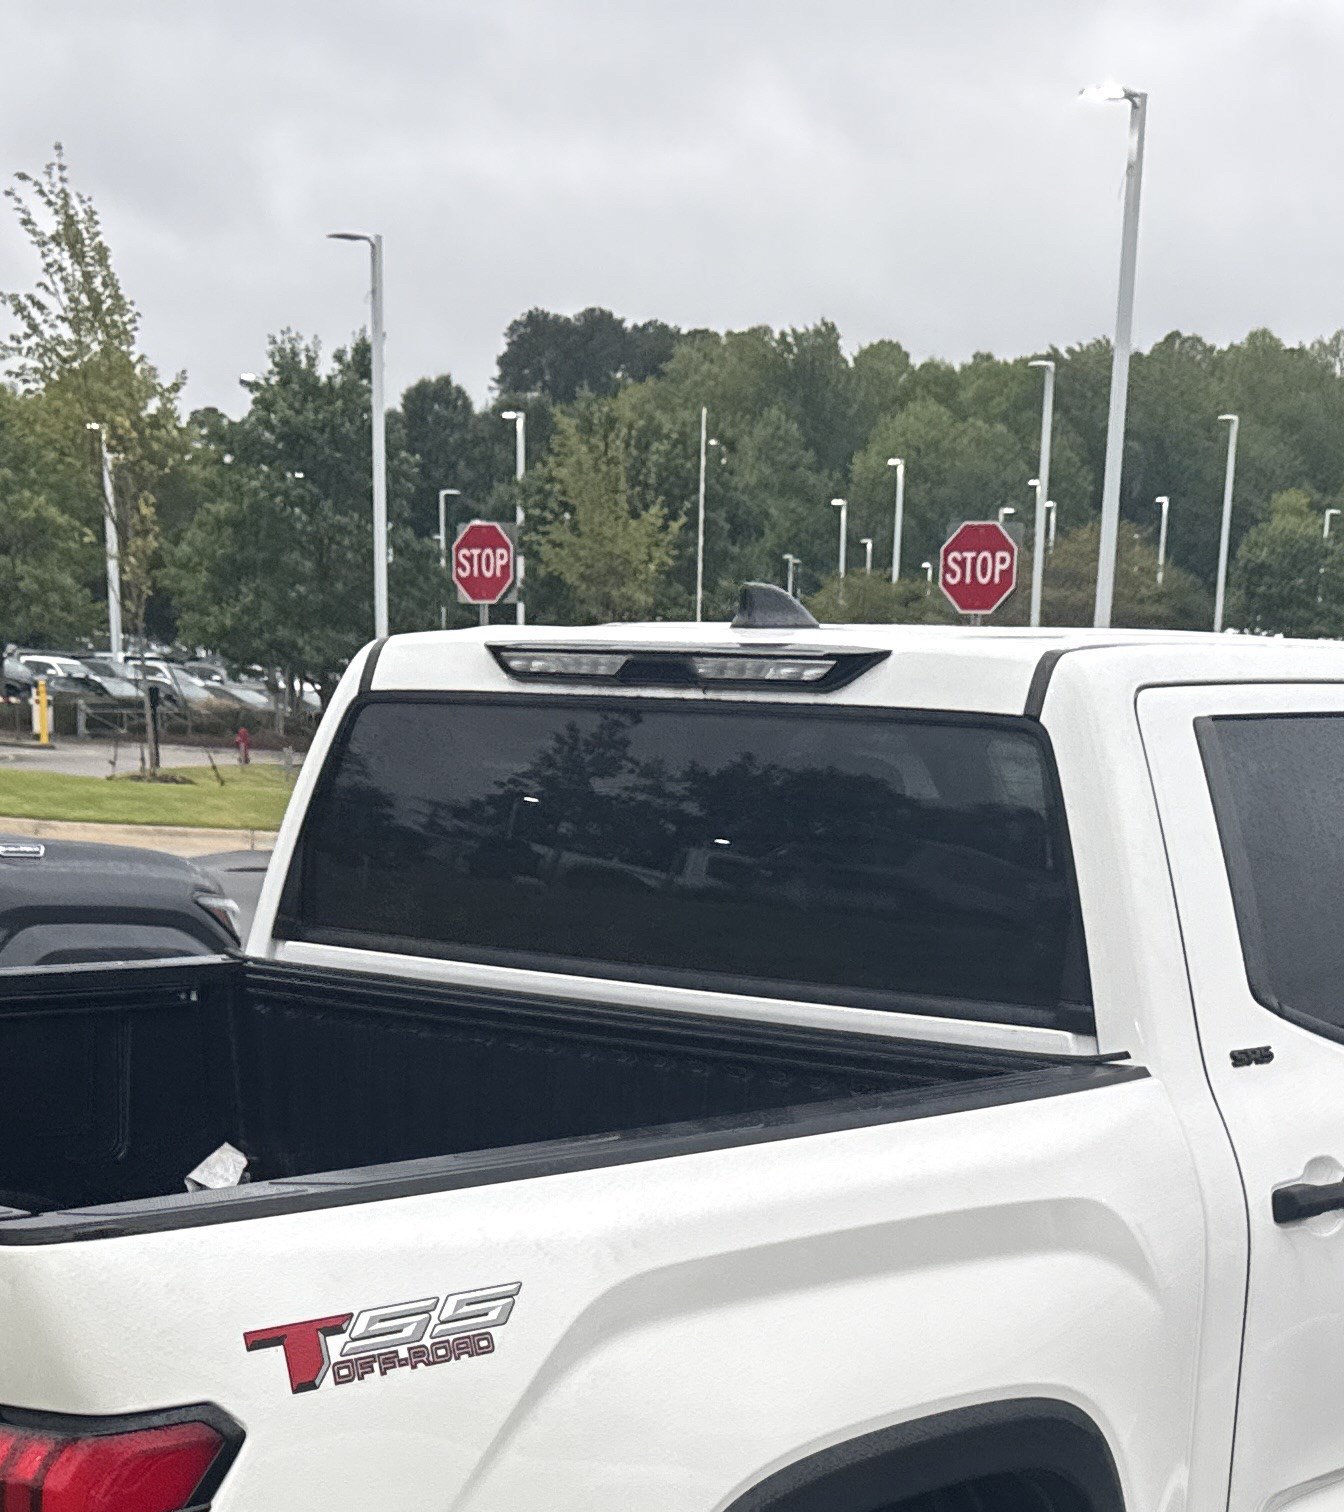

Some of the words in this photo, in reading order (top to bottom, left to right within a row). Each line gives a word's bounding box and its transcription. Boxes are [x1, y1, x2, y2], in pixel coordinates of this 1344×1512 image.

[457, 547, 508, 578] STOP
[945, 551, 1011, 585] STOP
[332, 1331, 495, 1385] OFF-ROAD
